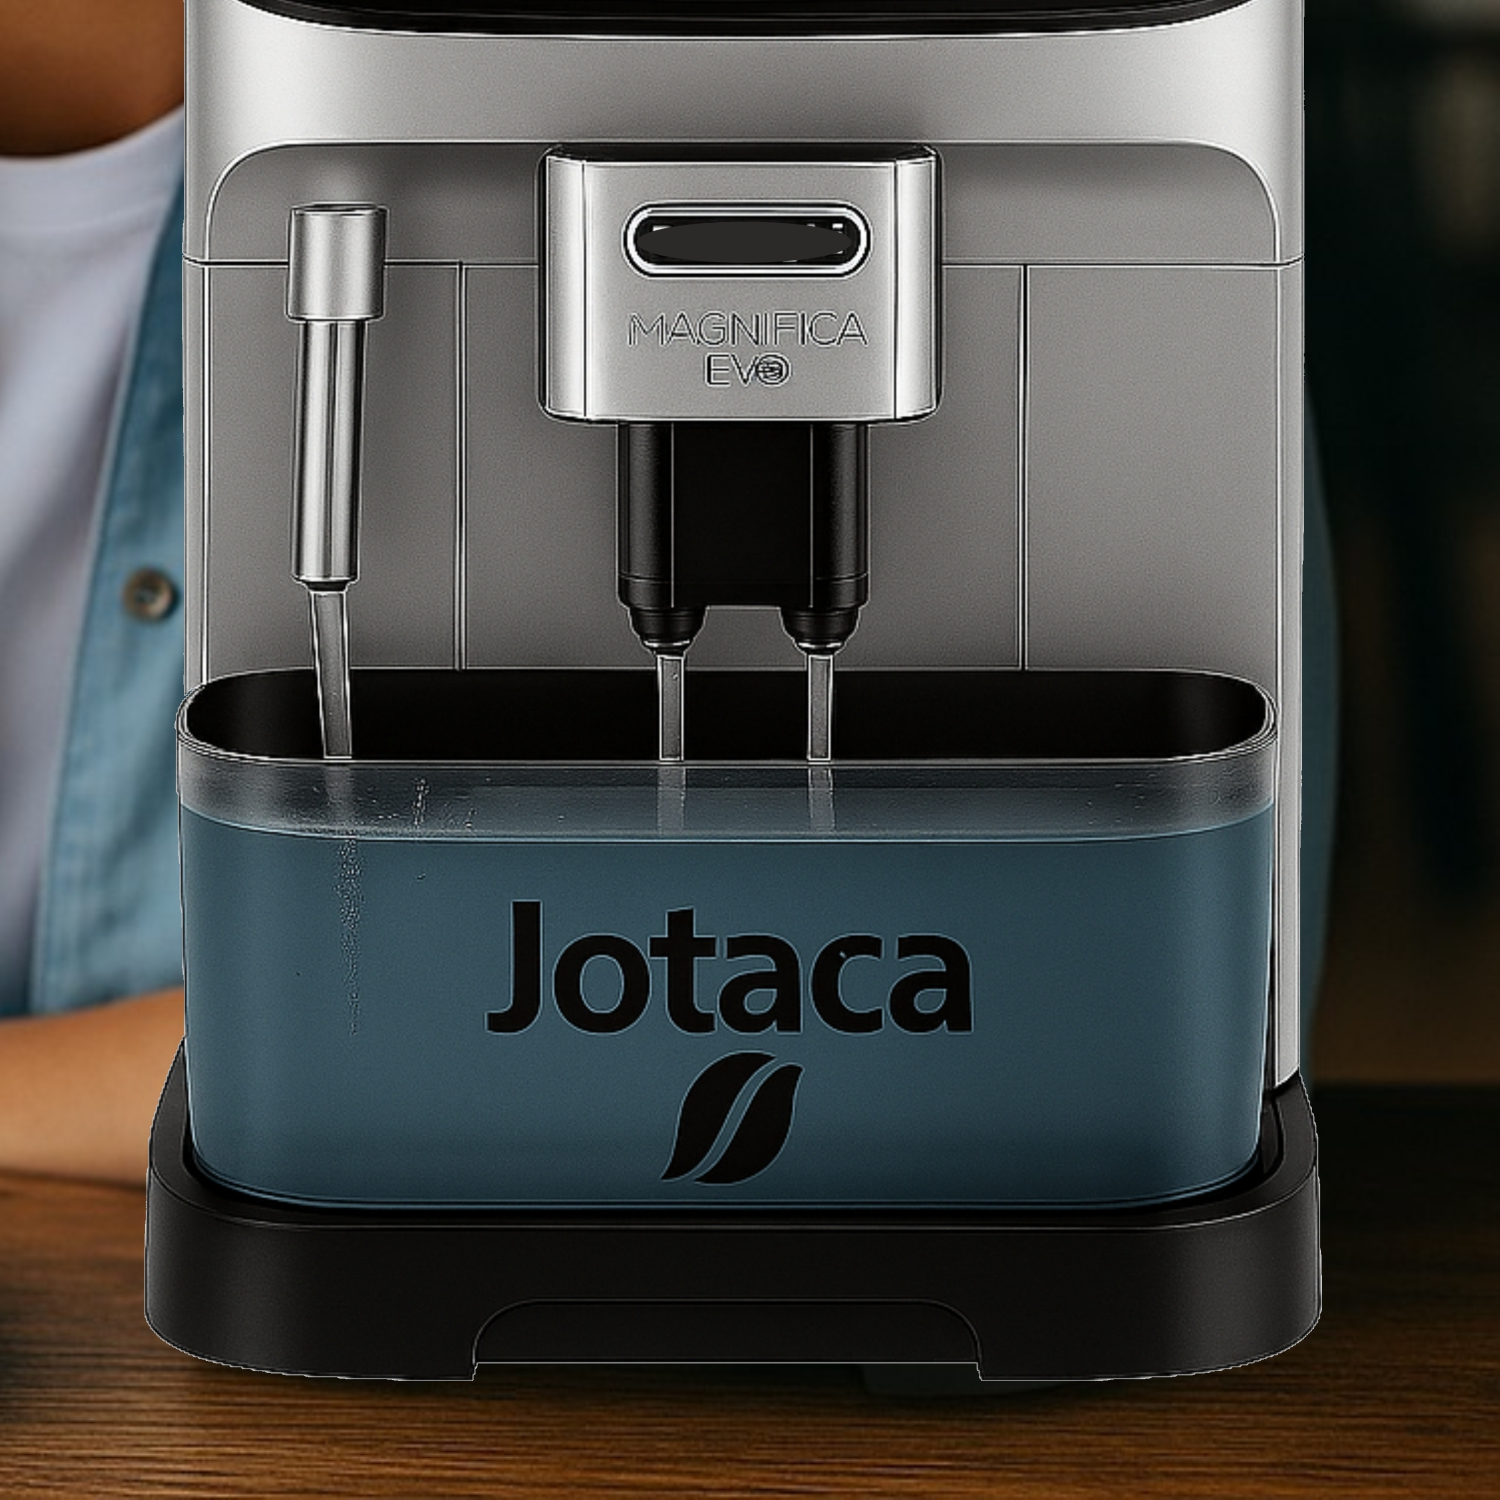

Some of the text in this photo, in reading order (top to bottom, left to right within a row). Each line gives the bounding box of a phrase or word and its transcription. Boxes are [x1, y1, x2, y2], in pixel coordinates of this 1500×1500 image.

[628, 311, 868, 345] MAGNIFICA
[705, 353, 791, 387] EVO
[486, 899, 973, 1034] Jotaca
